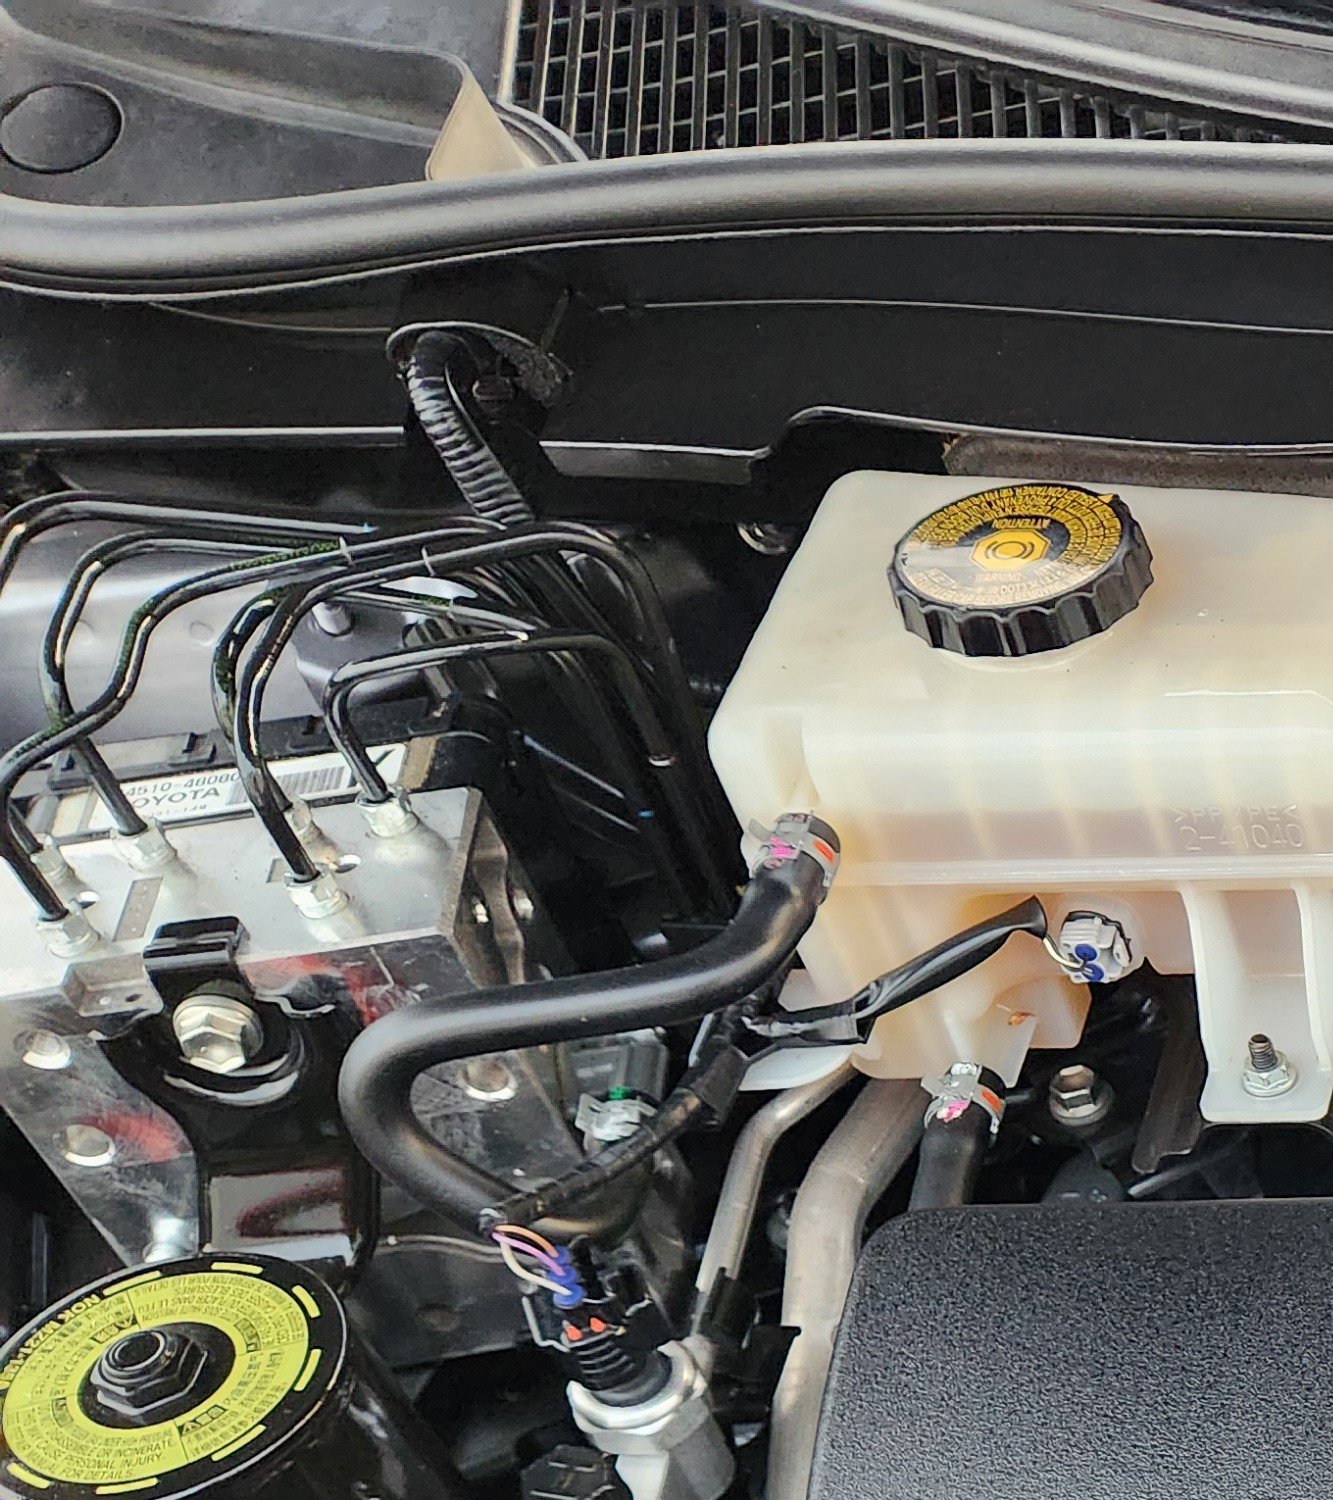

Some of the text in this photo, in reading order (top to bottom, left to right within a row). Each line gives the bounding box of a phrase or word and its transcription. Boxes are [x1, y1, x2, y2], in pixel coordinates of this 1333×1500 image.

[991, 518, 1050, 530] ATTENTION
[132, 787, 220, 808] OYOTA
[58, 1294, 101, 1323] NOK
